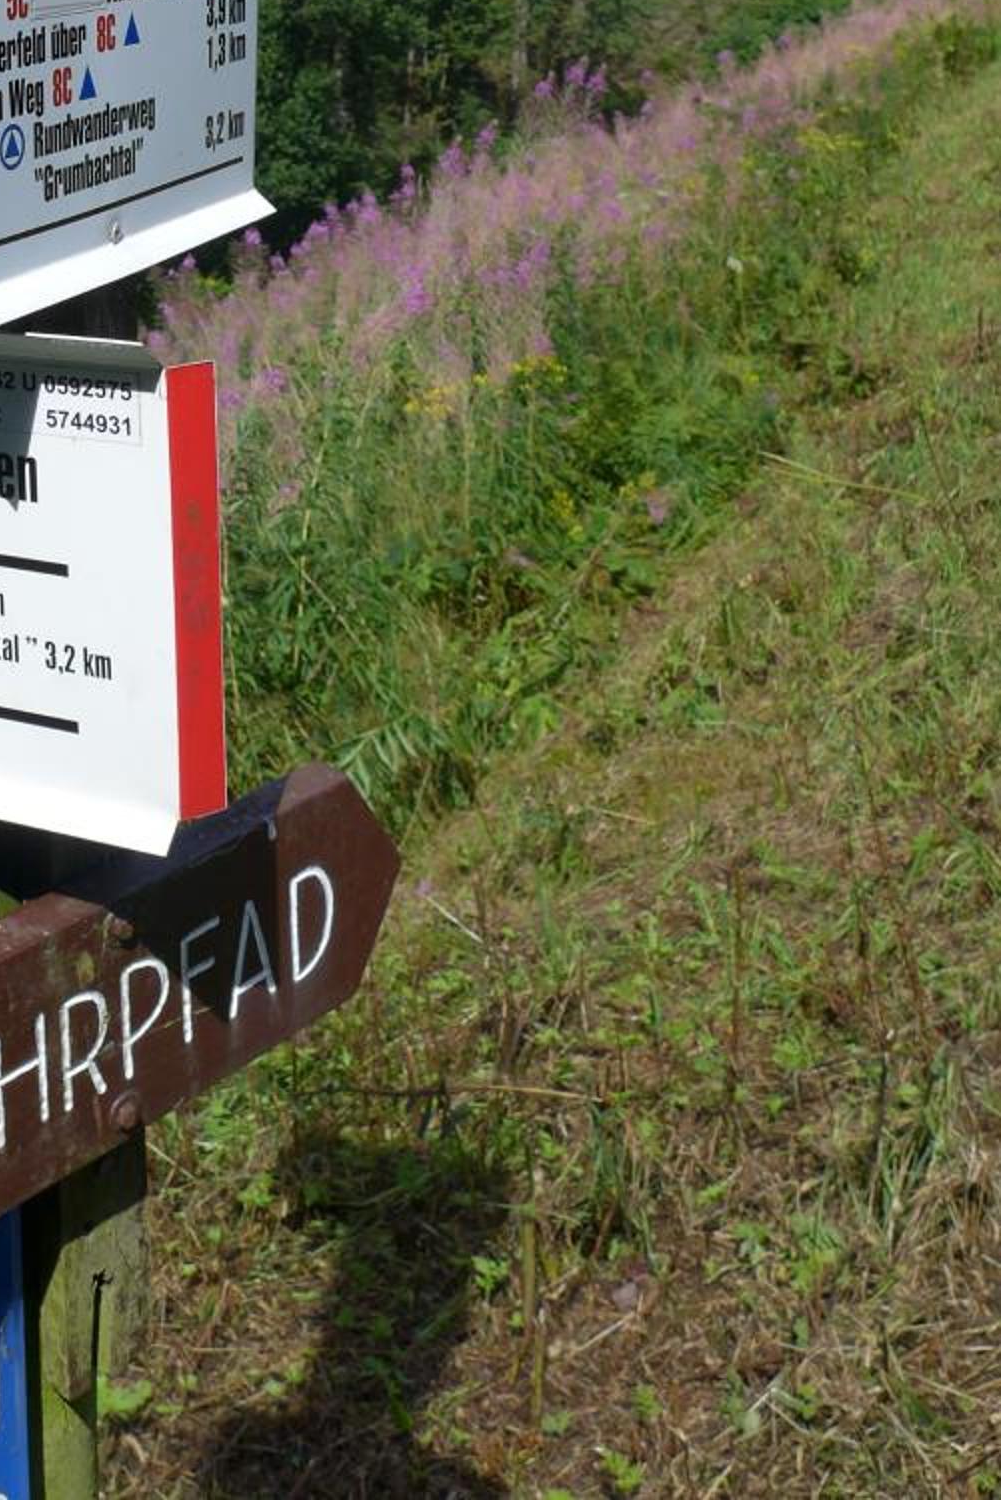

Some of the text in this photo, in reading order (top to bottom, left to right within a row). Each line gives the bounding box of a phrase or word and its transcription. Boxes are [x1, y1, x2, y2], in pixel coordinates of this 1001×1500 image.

[97, 13, 116, 53] 8C
[9, 78, 44, 117] Weg
[53, 67, 72, 107] 8C
[207, 34, 226, 70] 1,3
[229, 33, 246, 62] km
[34, 98, 244, 159] Rundwanderweg 3,2 km
[22, 372, 36, 393] U
[44, 374, 133, 401] 0592575
[45, 409, 133, 437] 5744931
[45, 641, 76, 675] 3,2
[84, 647, 112, 681] km
